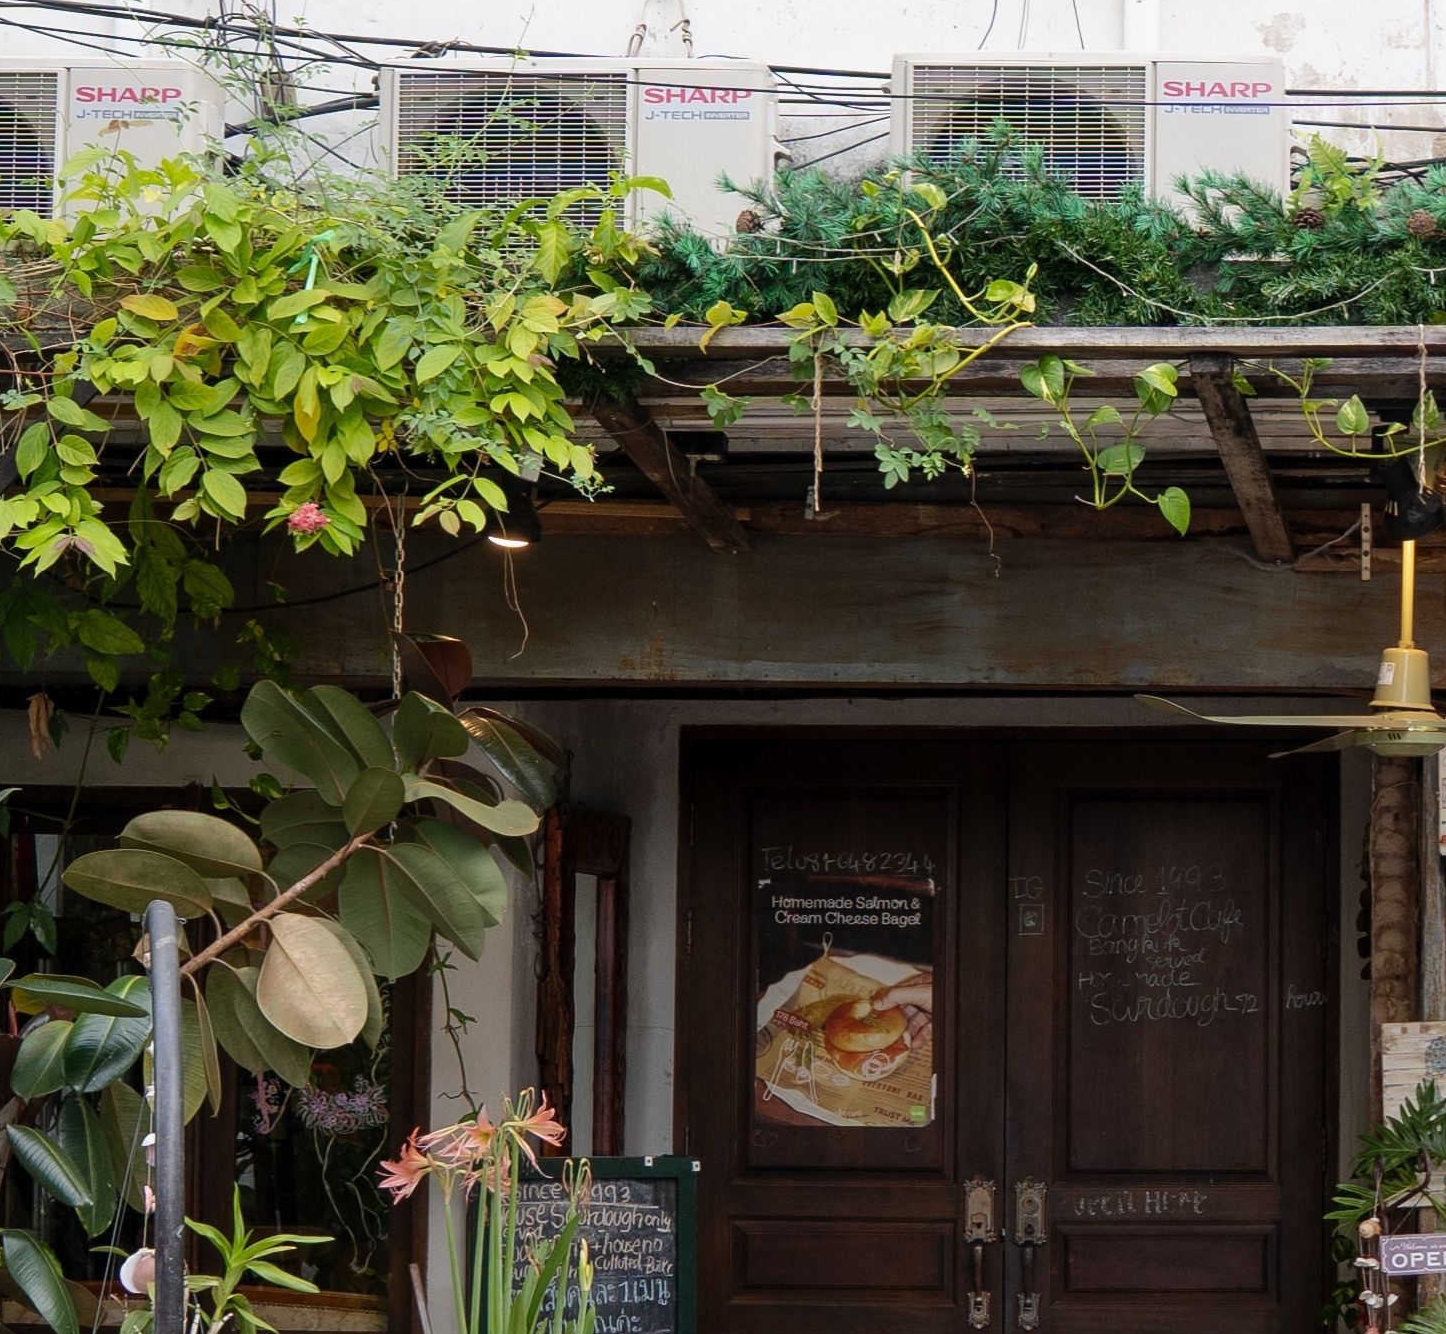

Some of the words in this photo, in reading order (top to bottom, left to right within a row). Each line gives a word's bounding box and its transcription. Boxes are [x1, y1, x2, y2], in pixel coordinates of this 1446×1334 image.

[75, 86, 183, 104] SHARP
[643, 87, 753, 104] SHARP
[1163, 81, 1273, 98] SHARP
[75, 110, 131, 120] J-TECH
[644, 110, 702, 121] J-TECH
[1082, 868, 1147, 899] Since
[1158, 863, 1228, 895] 1993
[771, 896, 854, 910] Homemade
[856, 896, 908, 910] Salmon
[910, 896, 921, 910] &
[774, 910, 822, 925] Cream
[825, 911, 879, 926] Cheese
[882, 912, 922, 928] Bagel
[1078, 969, 1202, 991] Hmade
[588, 1183, 631, 1205] 993
